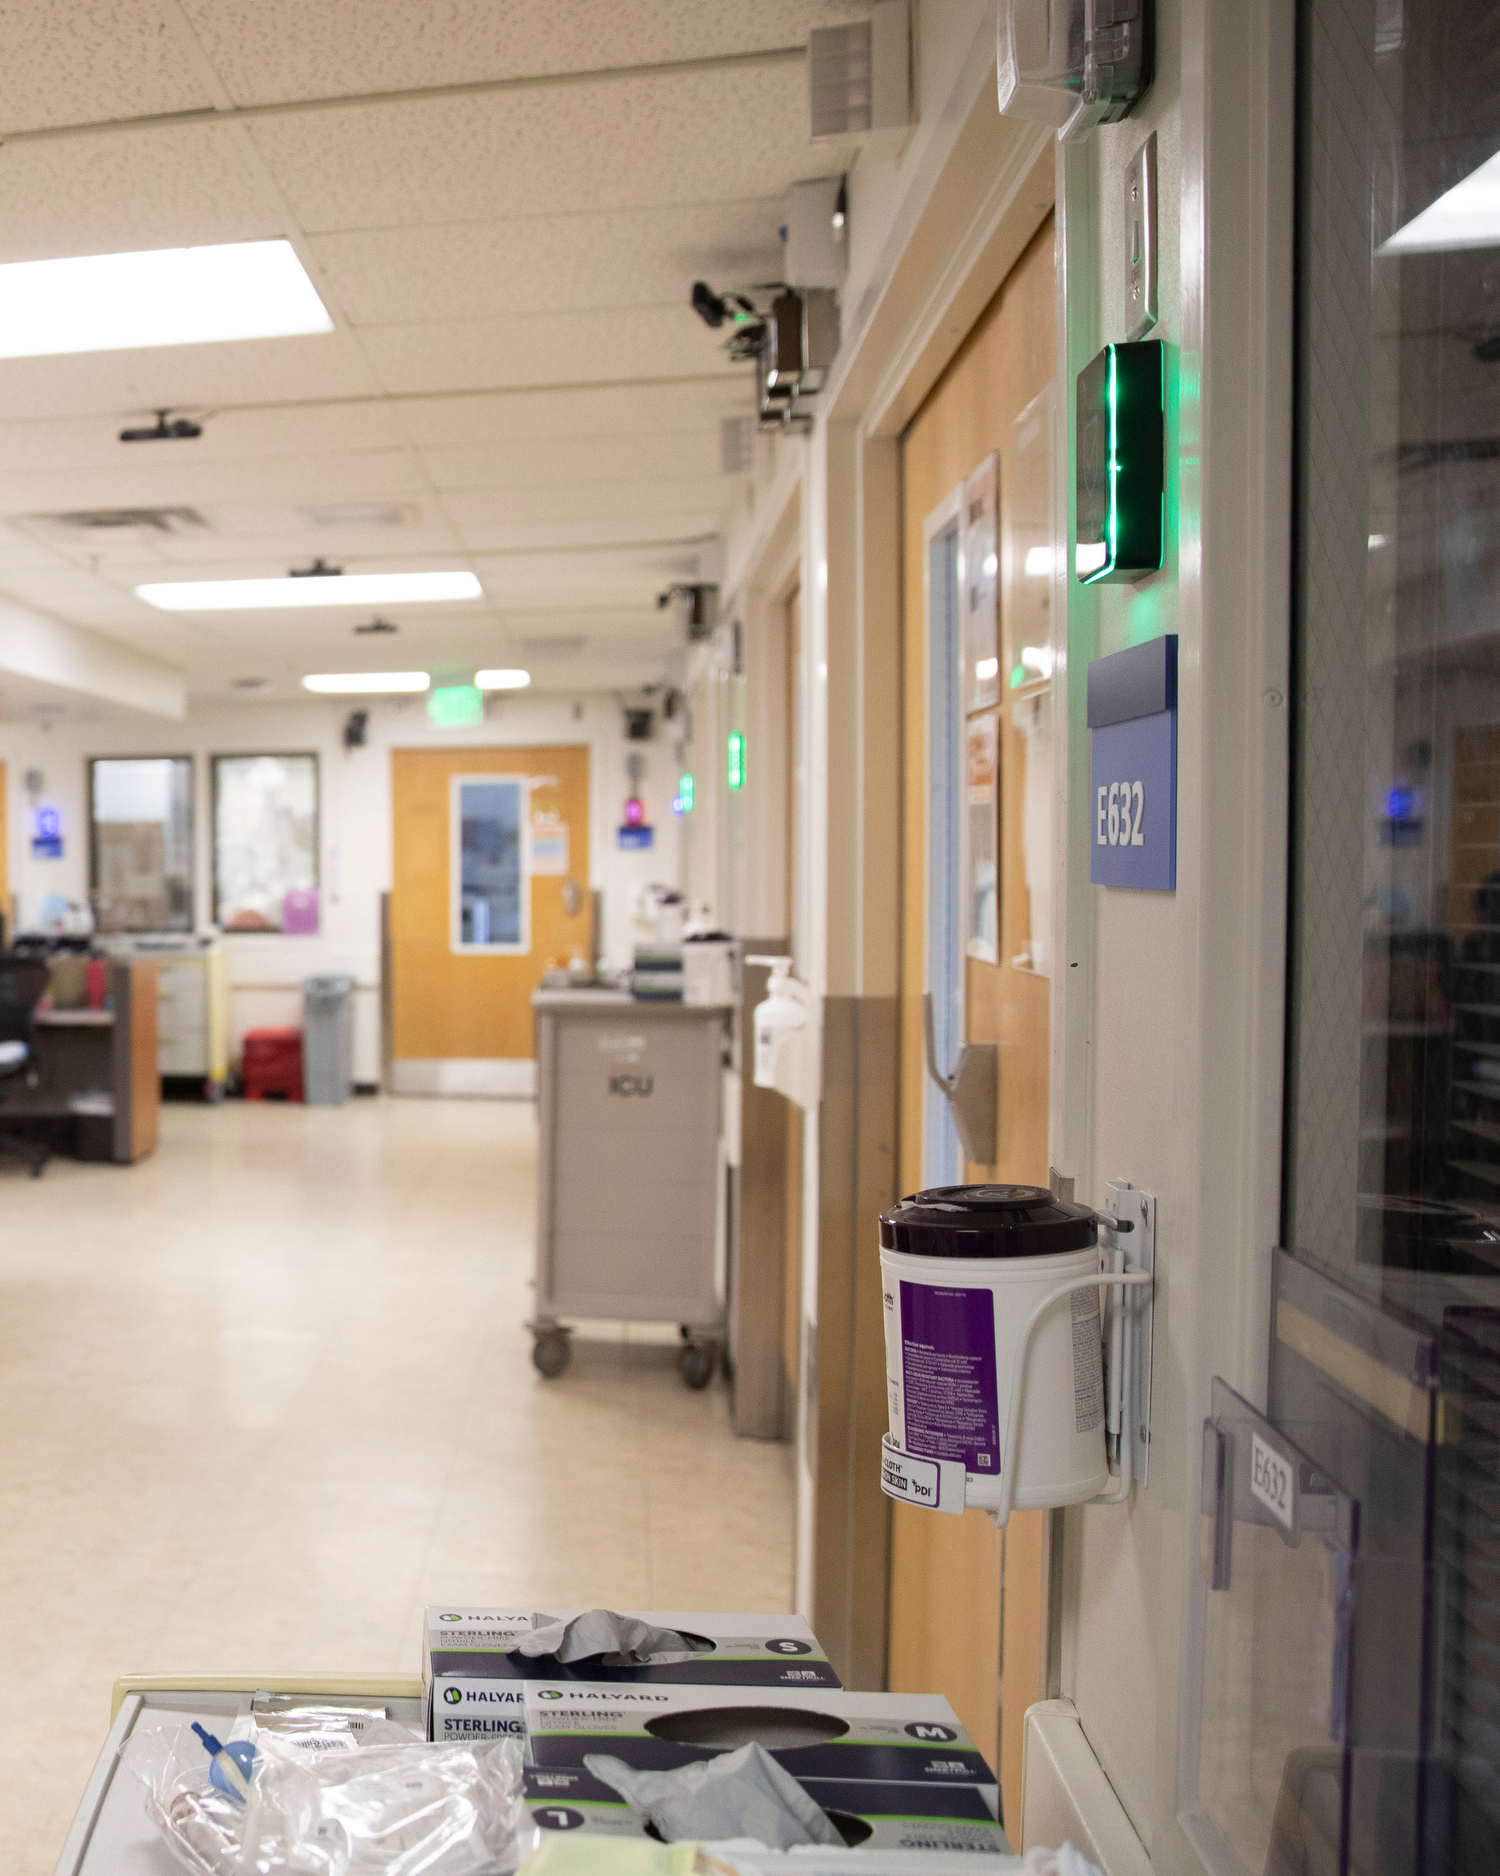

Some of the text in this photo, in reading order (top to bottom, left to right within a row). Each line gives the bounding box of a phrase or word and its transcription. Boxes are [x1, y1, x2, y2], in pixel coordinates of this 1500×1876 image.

[1096, 780, 1145, 847] E632
[608, 1073, 654, 1097] ICU
[891, 1475, 908, 1491] SKIN
[1253, 1445, 1287, 1510] E632
[779, 1642, 798, 1652] S
[569, 1692, 669, 1702] HALYARD
[538, 1710, 624, 1718] STERLING
[444, 1718, 520, 1733] STERLING
[915, 1725, 948, 1740] M
[546, 1810, 568, 1828] L
[899, 1838, 1001, 1853] STERLING
